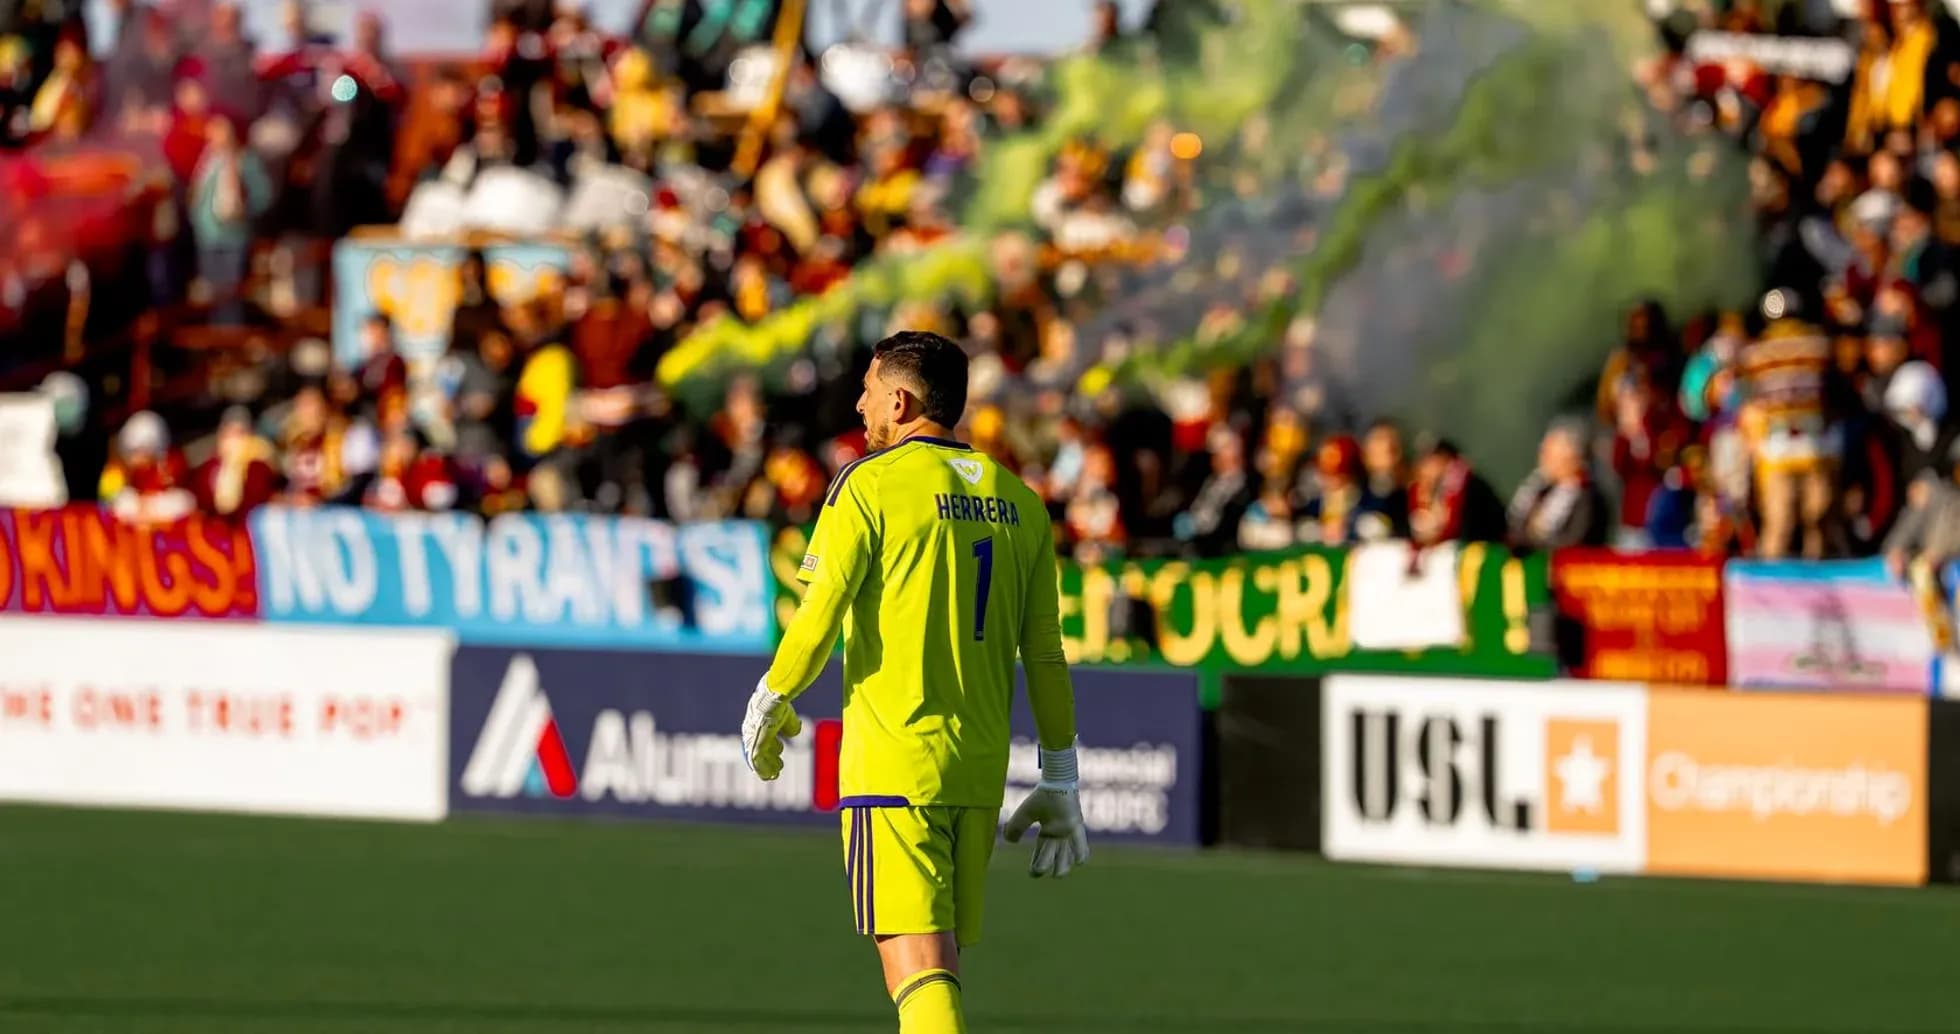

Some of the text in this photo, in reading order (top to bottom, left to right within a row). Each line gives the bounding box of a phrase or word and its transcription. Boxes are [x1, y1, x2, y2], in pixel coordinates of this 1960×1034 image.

[934, 493, 1019, 526] HERRERA
[262, 504, 378, 616] NO
[972, 536, 994, 642] 1
[72, 685, 164, 731] ONE
[184, 688, 296, 736] TRUE
[318, 694, 406, 740] POP
[1350, 709, 1533, 832] USL
[1652, 751, 1913, 824] Championship
